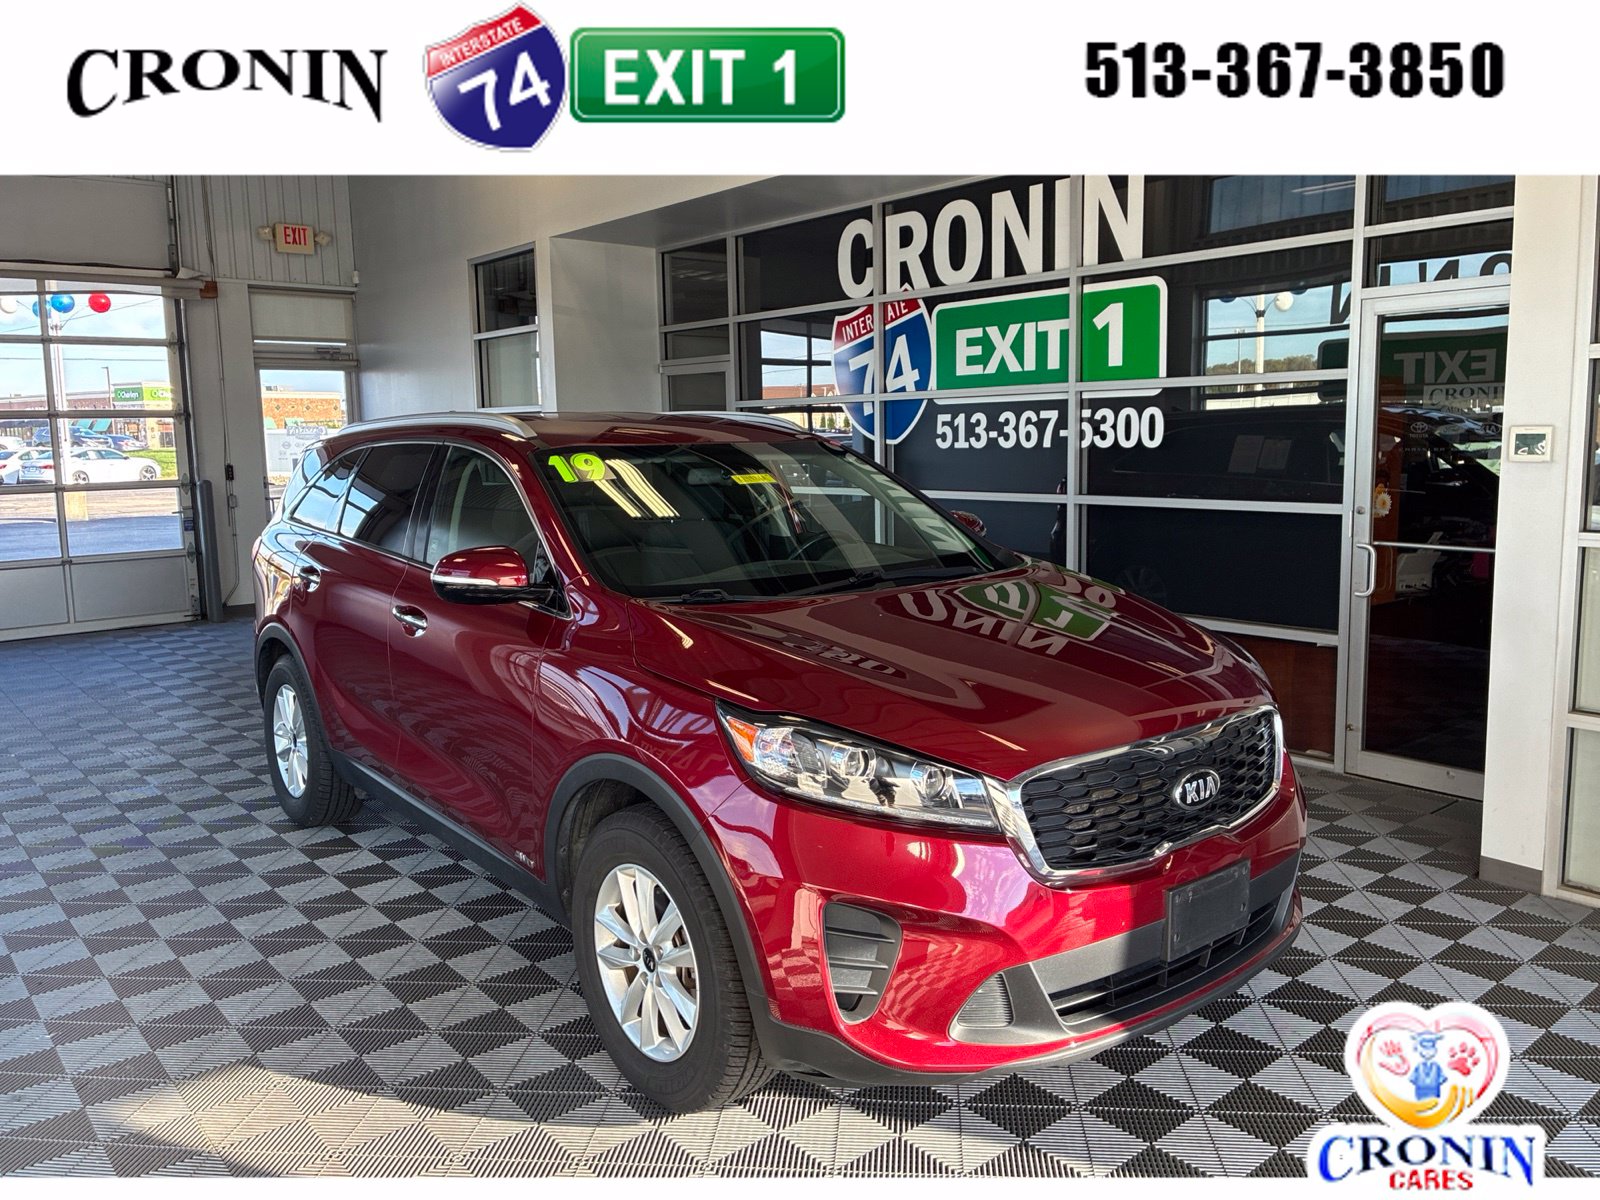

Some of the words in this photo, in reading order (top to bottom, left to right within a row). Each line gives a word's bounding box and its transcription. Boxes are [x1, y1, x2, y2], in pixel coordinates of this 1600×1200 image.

[283, 224, 308, 246] EXIT
[837, 174, 1145, 299] CRONIN
[841, 301, 909, 342] INTERATE
[955, 318, 1070, 377] EXIT
[1092, 302, 1124, 368] 1
[935, 406, 1165, 449] 513-367-5300
[547, 452, 607, 483] 19
[1184, 775, 1217, 804] KIA
